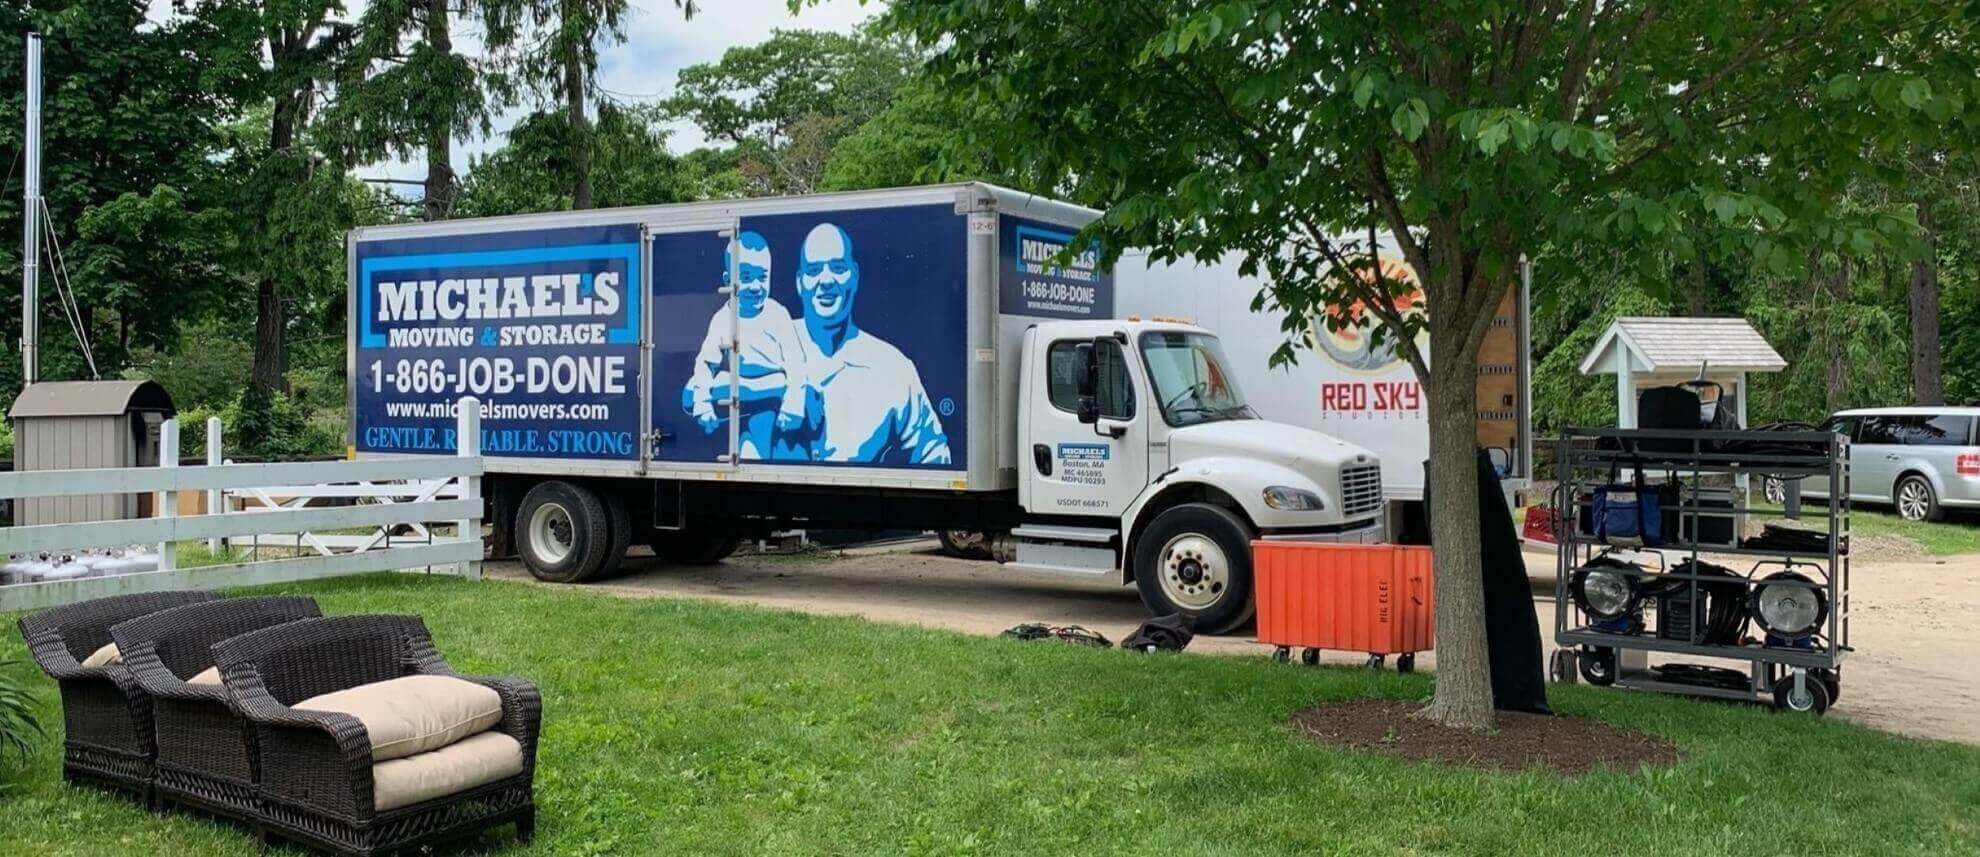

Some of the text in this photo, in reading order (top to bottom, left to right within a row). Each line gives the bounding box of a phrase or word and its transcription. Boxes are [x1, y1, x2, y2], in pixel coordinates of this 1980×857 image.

[378, 272, 620, 322] MICHAEL'S
[1022, 280, 1096, 304] 1-866-JOB-DONE
[389, 323, 606, 348] MOVING & STORAGE
[370, 355, 627, 394] 1-866-JOB-DONE
[1322, 382, 1420, 411] RED SKY
[386, 398, 610, 421] www.micelsmovers.com
[447, 428, 545, 452] RIABLE.
[548, 431, 634, 456] STRONG
[1092, 460, 1105, 469] MA
[1057, 499, 1082, 507] USDOT
